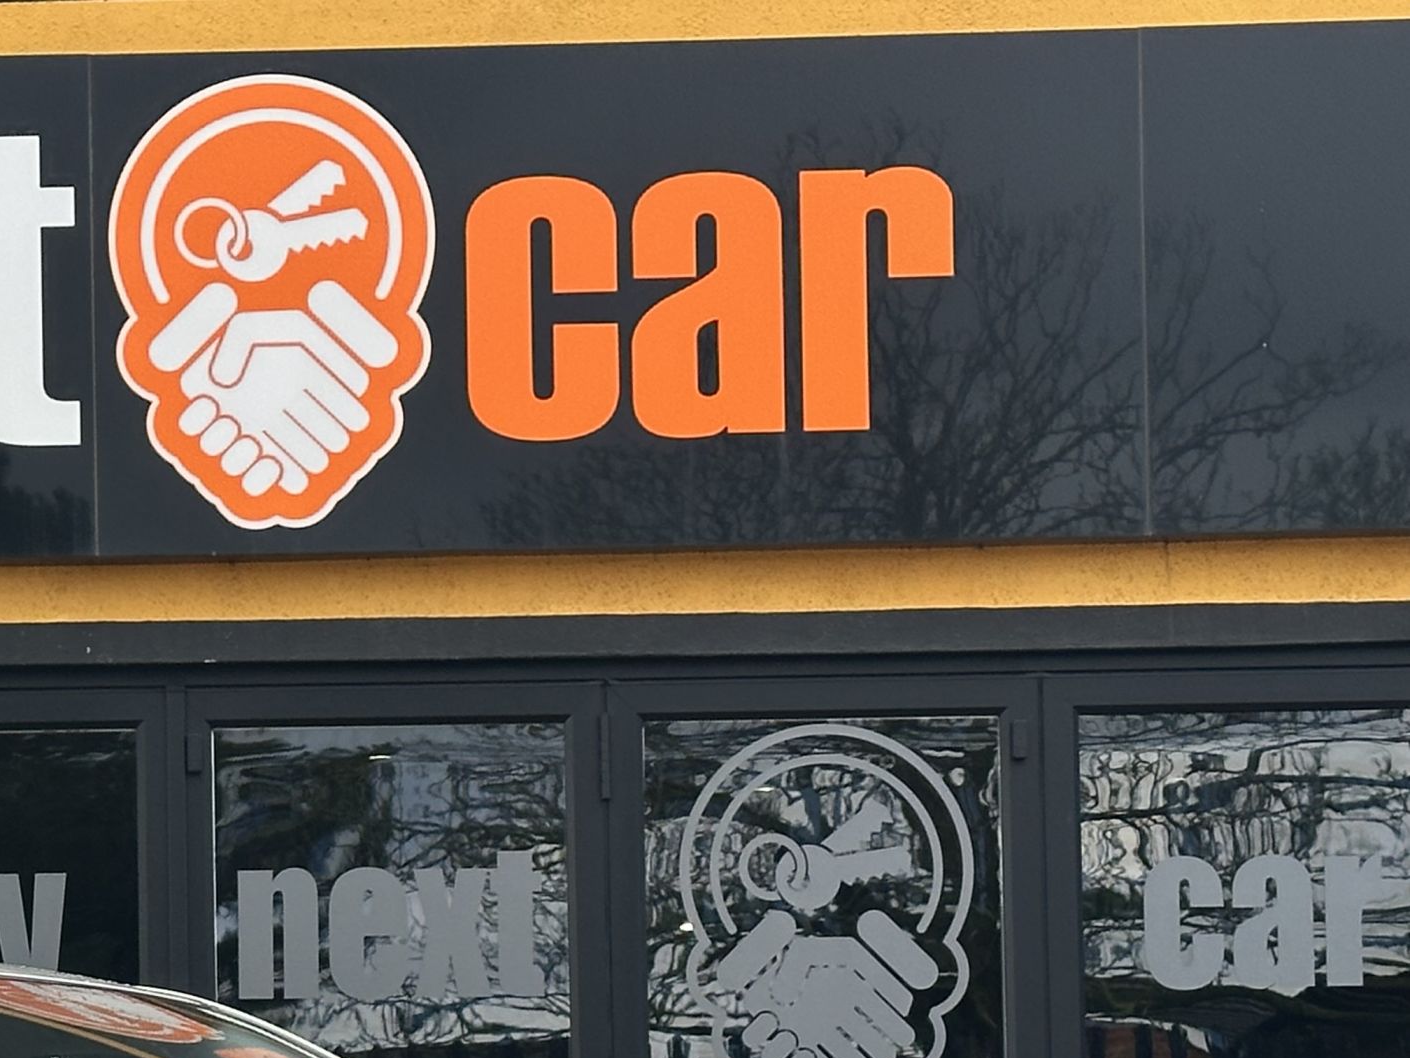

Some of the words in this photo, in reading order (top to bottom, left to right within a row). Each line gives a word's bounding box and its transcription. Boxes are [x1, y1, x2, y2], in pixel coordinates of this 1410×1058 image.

[466, 167, 954, 440] car
[237, 851, 547, 1001] next
[1143, 854, 1383, 991] car
